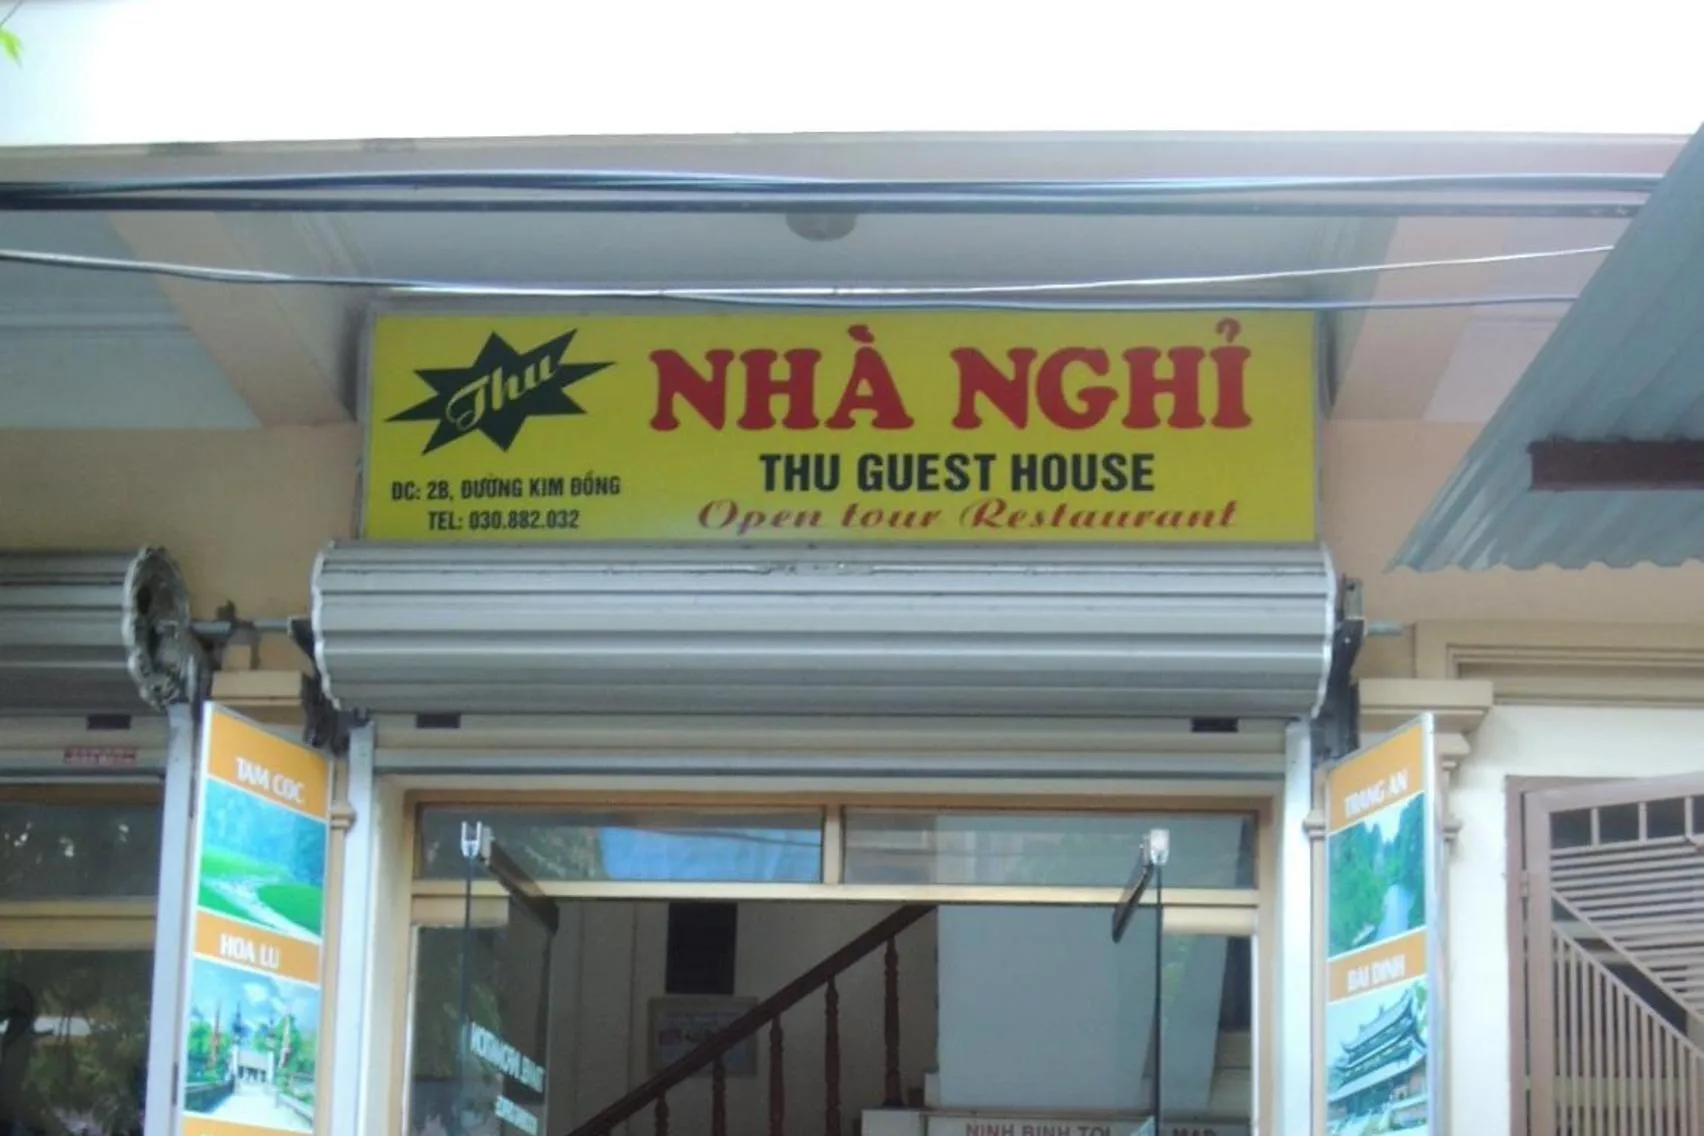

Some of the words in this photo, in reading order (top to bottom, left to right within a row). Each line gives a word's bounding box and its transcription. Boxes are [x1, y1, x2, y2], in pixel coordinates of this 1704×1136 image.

[445, 353, 557, 432] Thu
[648, 323, 915, 432] NHÀ
[949, 317, 1254, 431] NGHỈ
[529, 477, 565, 497] KIM
[759, 453, 841, 492] THU
[857, 452, 997, 493] GUEST
[1010, 452, 1156, 493] HOUSE
[428, 511, 463, 531] TEL:
[468, 509, 580, 530] 030.882.032
[697, 498, 823, 535] Open
[840, 502, 942, 530] tour
[958, 498, 1239, 530] Restaurant
[220, 932, 255, 962] HOA
